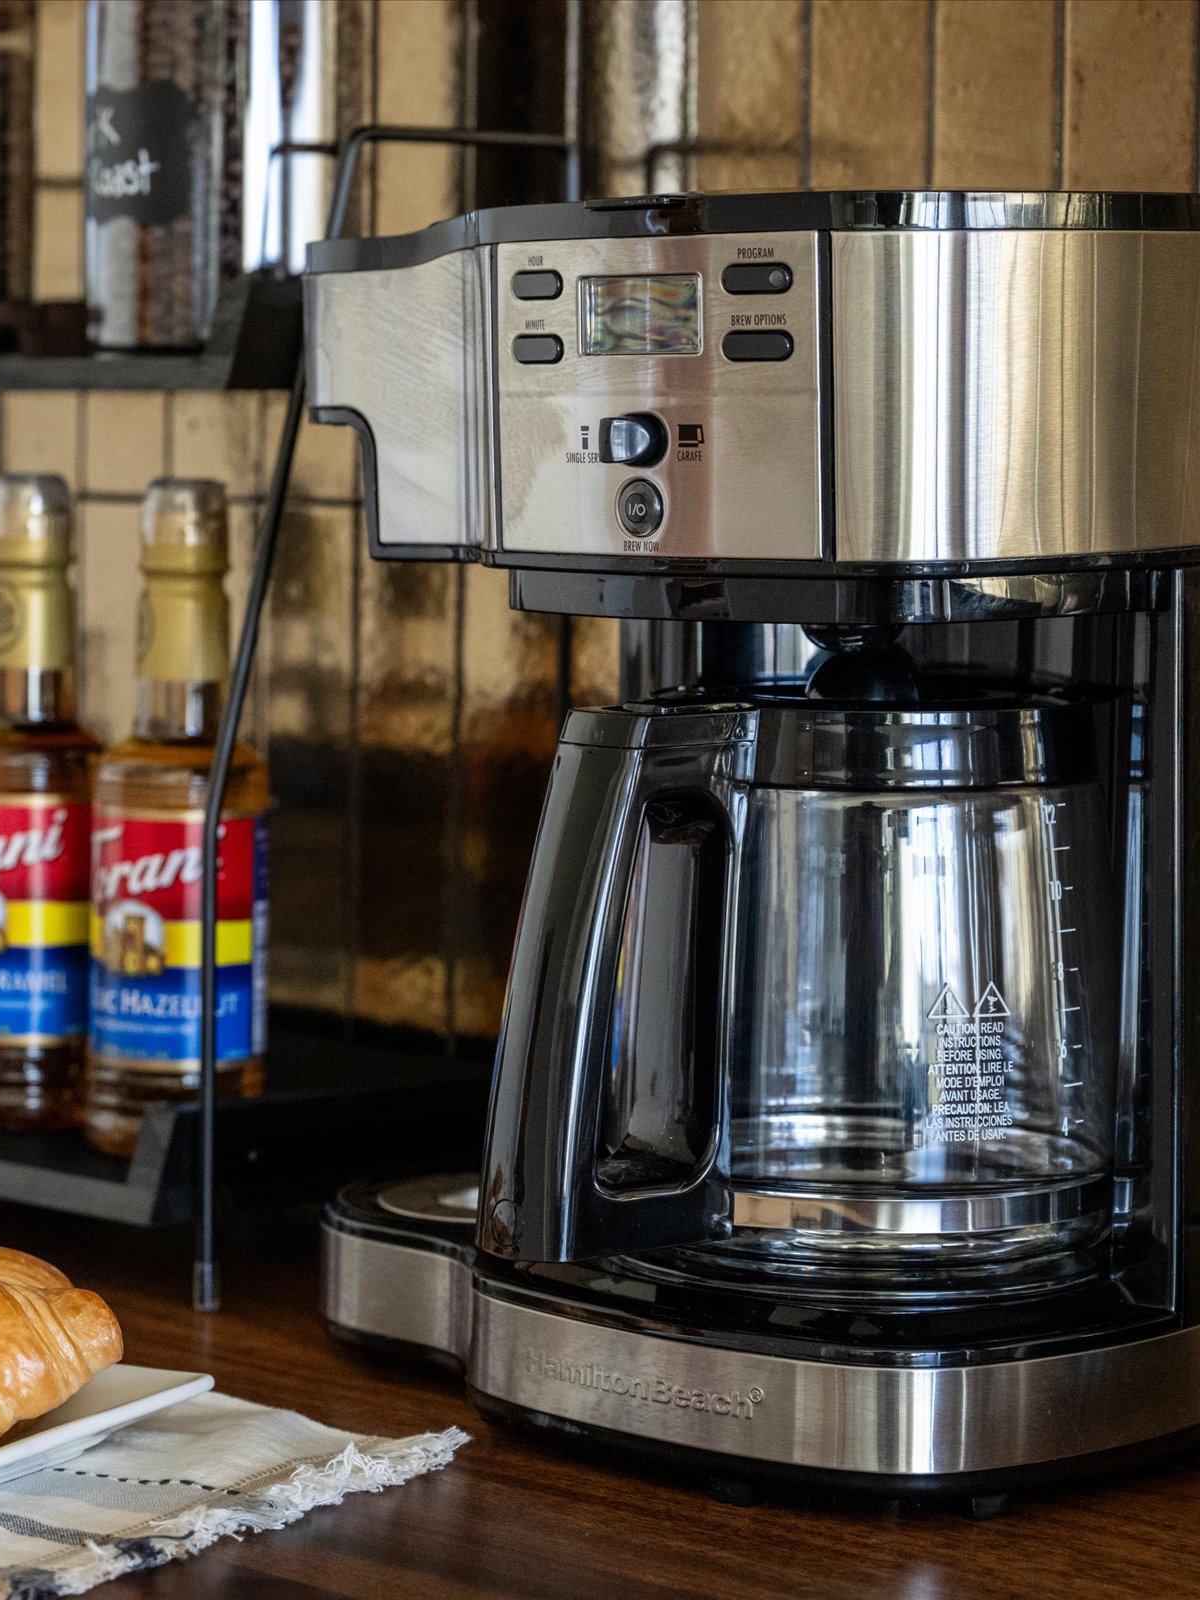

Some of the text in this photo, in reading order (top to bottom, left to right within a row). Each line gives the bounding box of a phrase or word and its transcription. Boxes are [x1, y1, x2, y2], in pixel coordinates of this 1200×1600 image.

[737, 247, 775, 259] PROGRAM
[527, 255, 544, 267] HOUR
[525, 319, 546, 331] MINUTE
[730, 313, 787, 326] BREW OPTIONS
[565, 452, 586, 464] SINGLE
[677, 450, 703, 462] CARAFE
[623, 540, 660, 553] BREW NOW
[1043, 804, 1057, 824] 12
[1050, 880, 1062, 900] 10
[1057, 961, 1064, 981] 8
[980, 1022, 1004, 1033] READ
[939, 1035, 1001, 1048] INSTRUCTIONS
[937, 1049, 1003, 1061] BEFORE USING.
[928, 1061, 1014, 1075] ATTENTION: LIRE LE
[936, 1075, 1005, 1088] MODE D'EMPLOI
[939, 1089, 1001, 1102] AVANT USAGE.
[993, 1101, 1010, 1113] LEA
[926, 1115, 1013, 1129] LAS INSTRUCCIONES
[1061, 1116, 1069, 1136] 4
[934, 1129, 1006, 1142] ANTES DE USAR.
